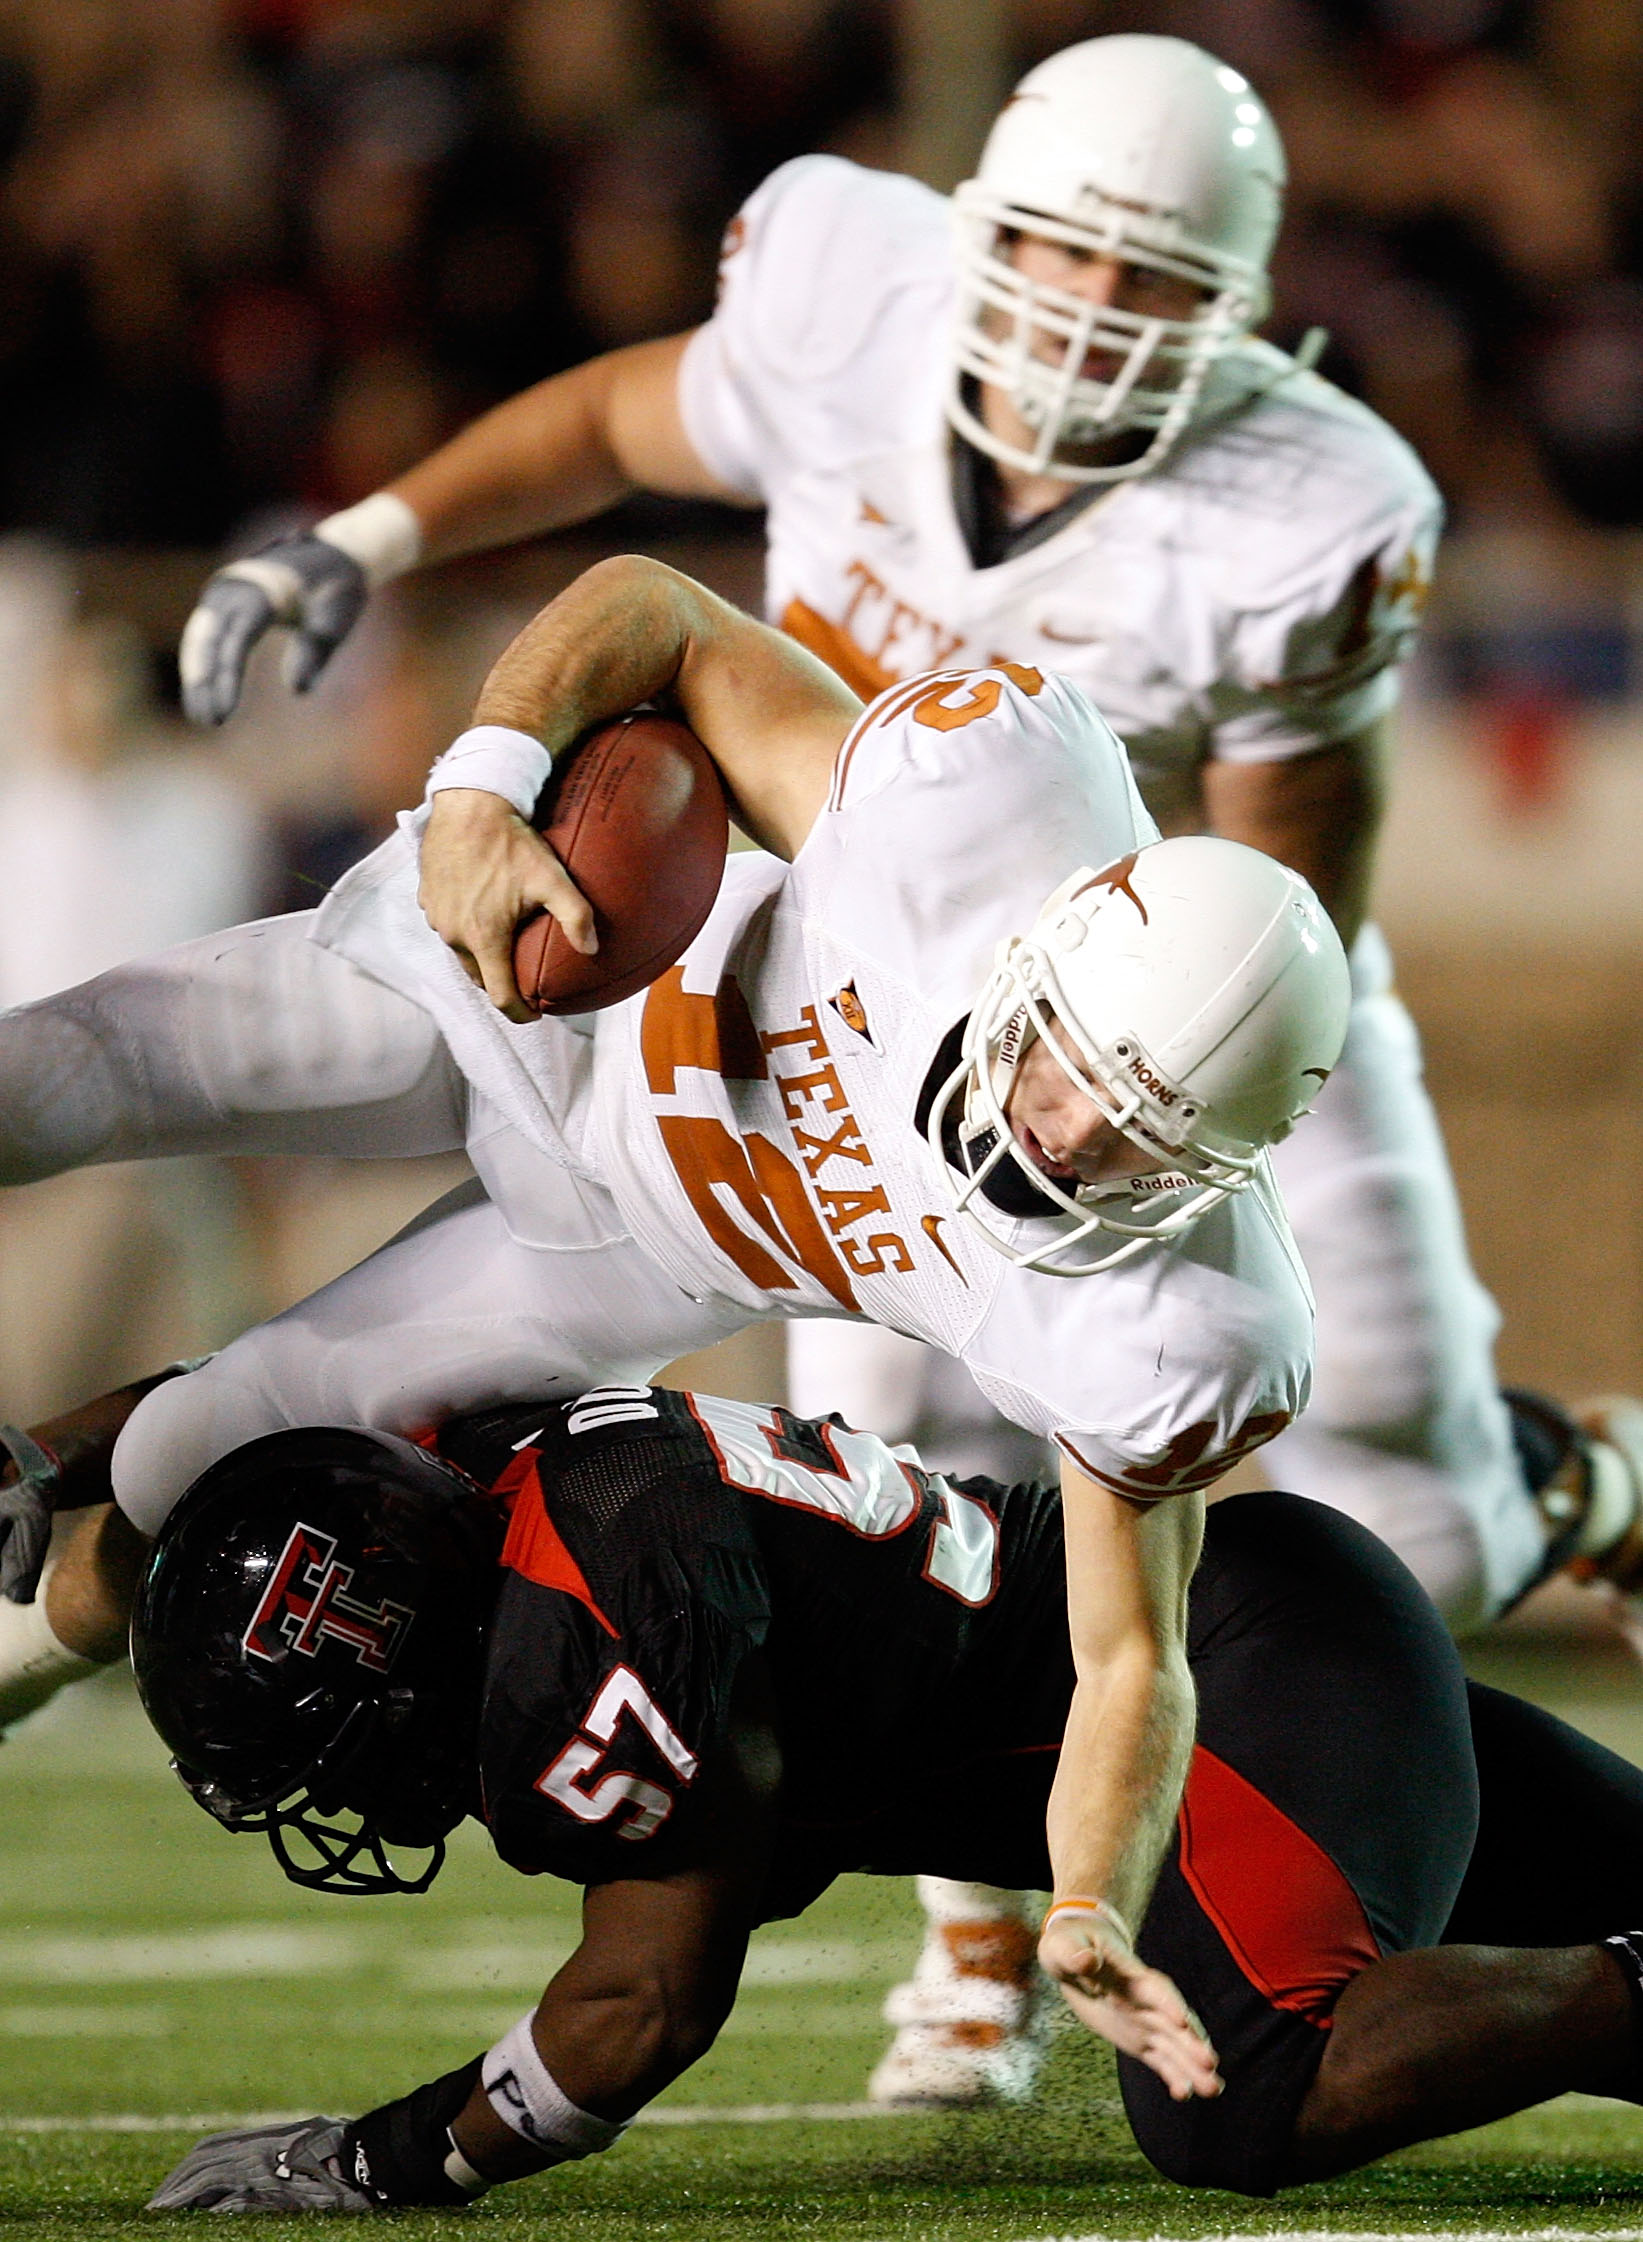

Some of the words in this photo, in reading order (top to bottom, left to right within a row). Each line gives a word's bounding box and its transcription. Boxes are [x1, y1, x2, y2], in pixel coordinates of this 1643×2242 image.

[640, 963, 863, 1312] 12
[759, 1003, 917, 1277] TEXAS
[1128, 1057, 1179, 1107] HORNS
[532, 1662, 701, 1844] 57
